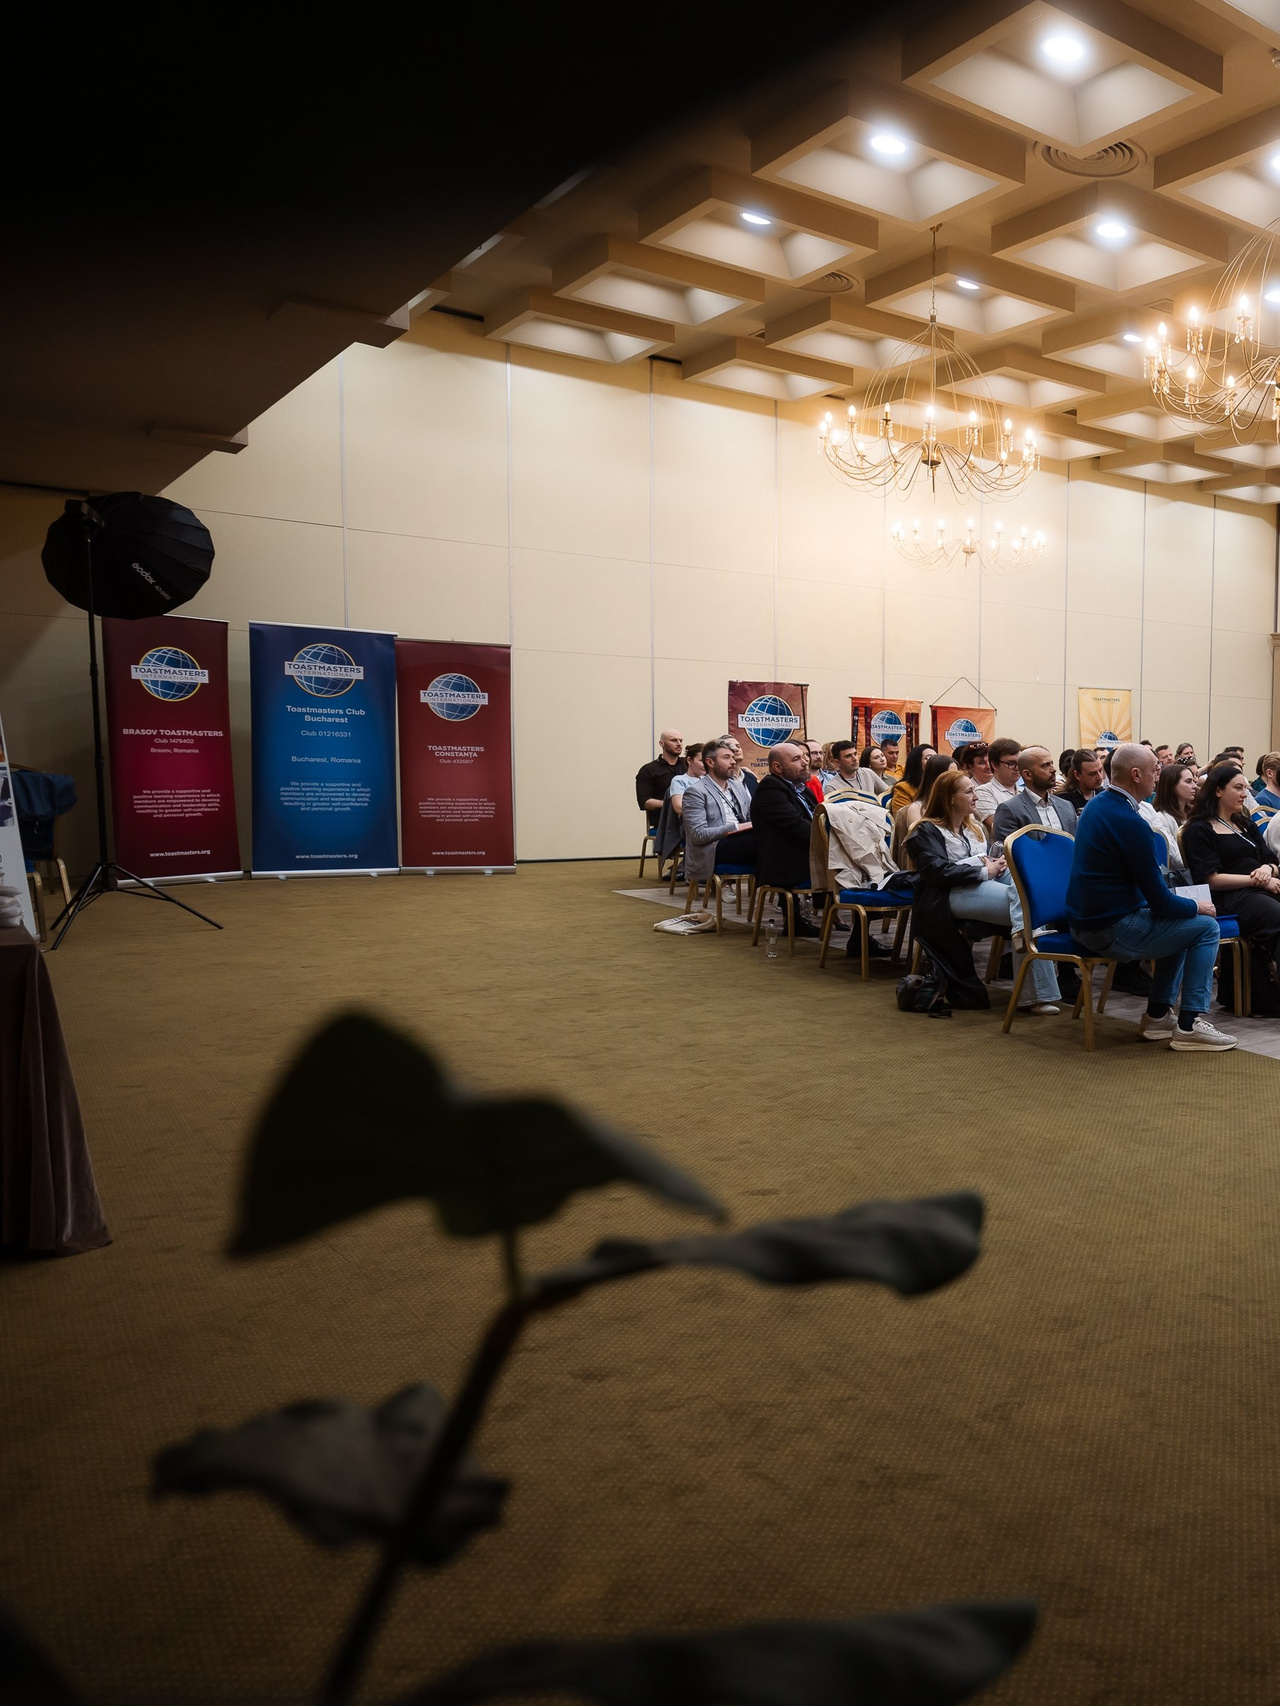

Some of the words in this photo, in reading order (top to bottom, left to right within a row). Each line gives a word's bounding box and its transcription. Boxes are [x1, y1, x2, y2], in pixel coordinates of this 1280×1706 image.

[132, 562, 156, 584] Godox
[133, 667, 206, 677] TOASTMASTERS
[287, 663, 361, 673] TOASTMASTERS
[295, 670, 353, 678] INTERNATIONAL
[286, 705, 343, 714] Toastmasters
[304, 715, 348, 723] Bucharest
[160, 729, 223, 737] TOASTMASTERS
[150, 849, 211, 857] www.toastmasters.org
